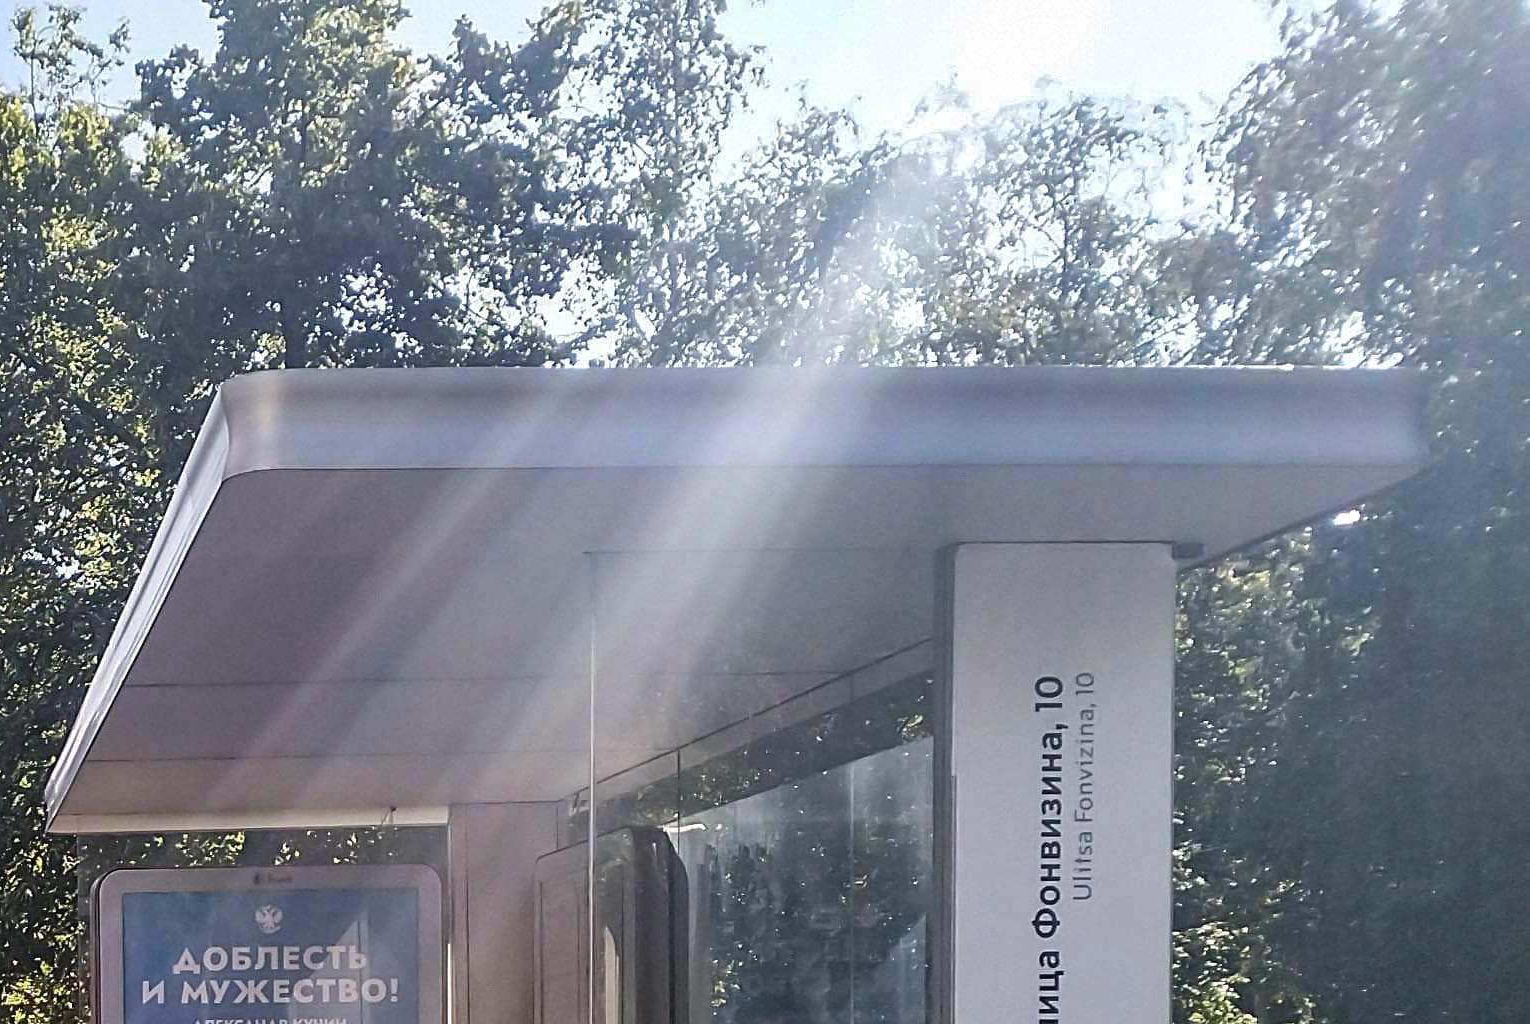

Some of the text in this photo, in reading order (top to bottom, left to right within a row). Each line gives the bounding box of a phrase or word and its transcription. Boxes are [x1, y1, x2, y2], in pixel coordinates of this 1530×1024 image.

[1034, 675, 1064, 713] 10
[1072, 672, 1097, 900] Ulitsa Fonvizina, 10
[1031, 723, 1069, 939] Фонвизина,
[172, 944, 368, 975] ДОБЛЕСТЬ
[141, 977, 400, 1005] И МУЖЕСТВО!
